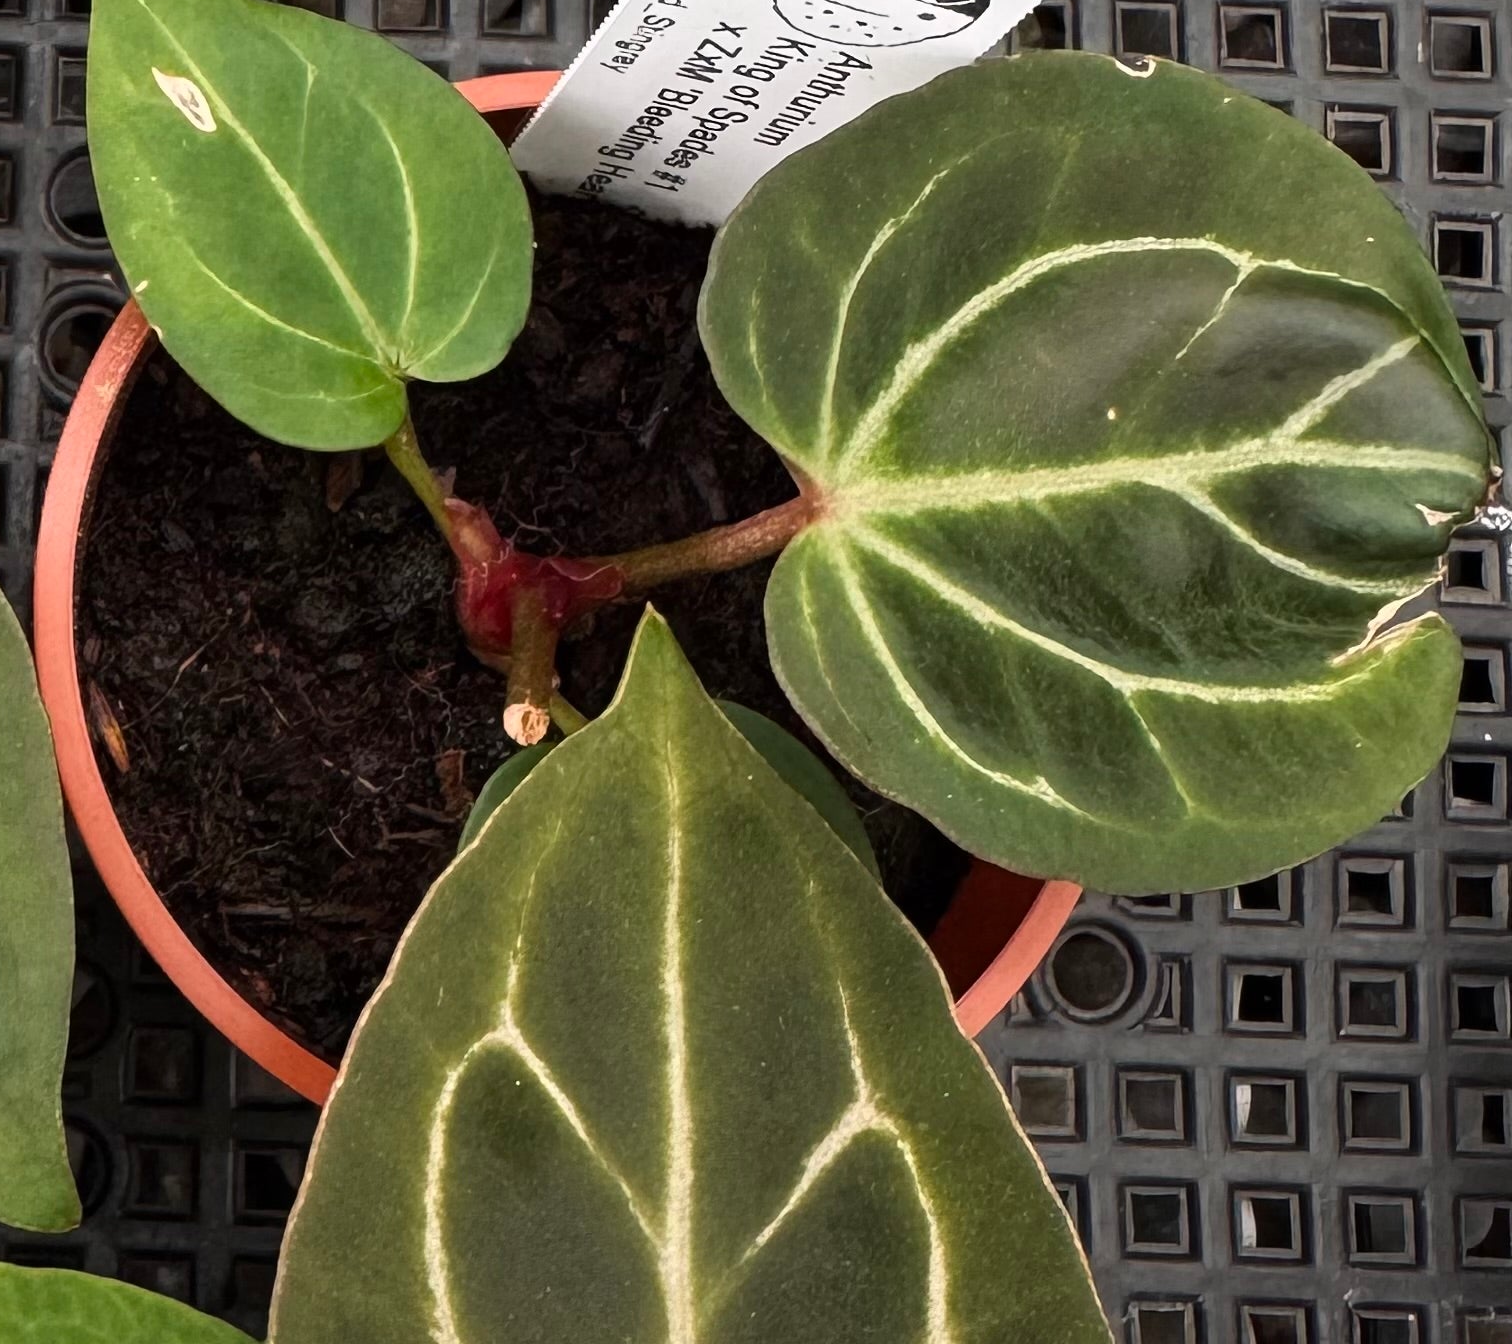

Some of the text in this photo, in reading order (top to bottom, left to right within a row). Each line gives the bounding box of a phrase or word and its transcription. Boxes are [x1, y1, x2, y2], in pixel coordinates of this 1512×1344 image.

[676, 38, 742, 84] ZxM
[712, 21, 748, 38] x
[644, 37, 817, 192] King of Spades #1
[754, 51, 873, 147] Anthurium
